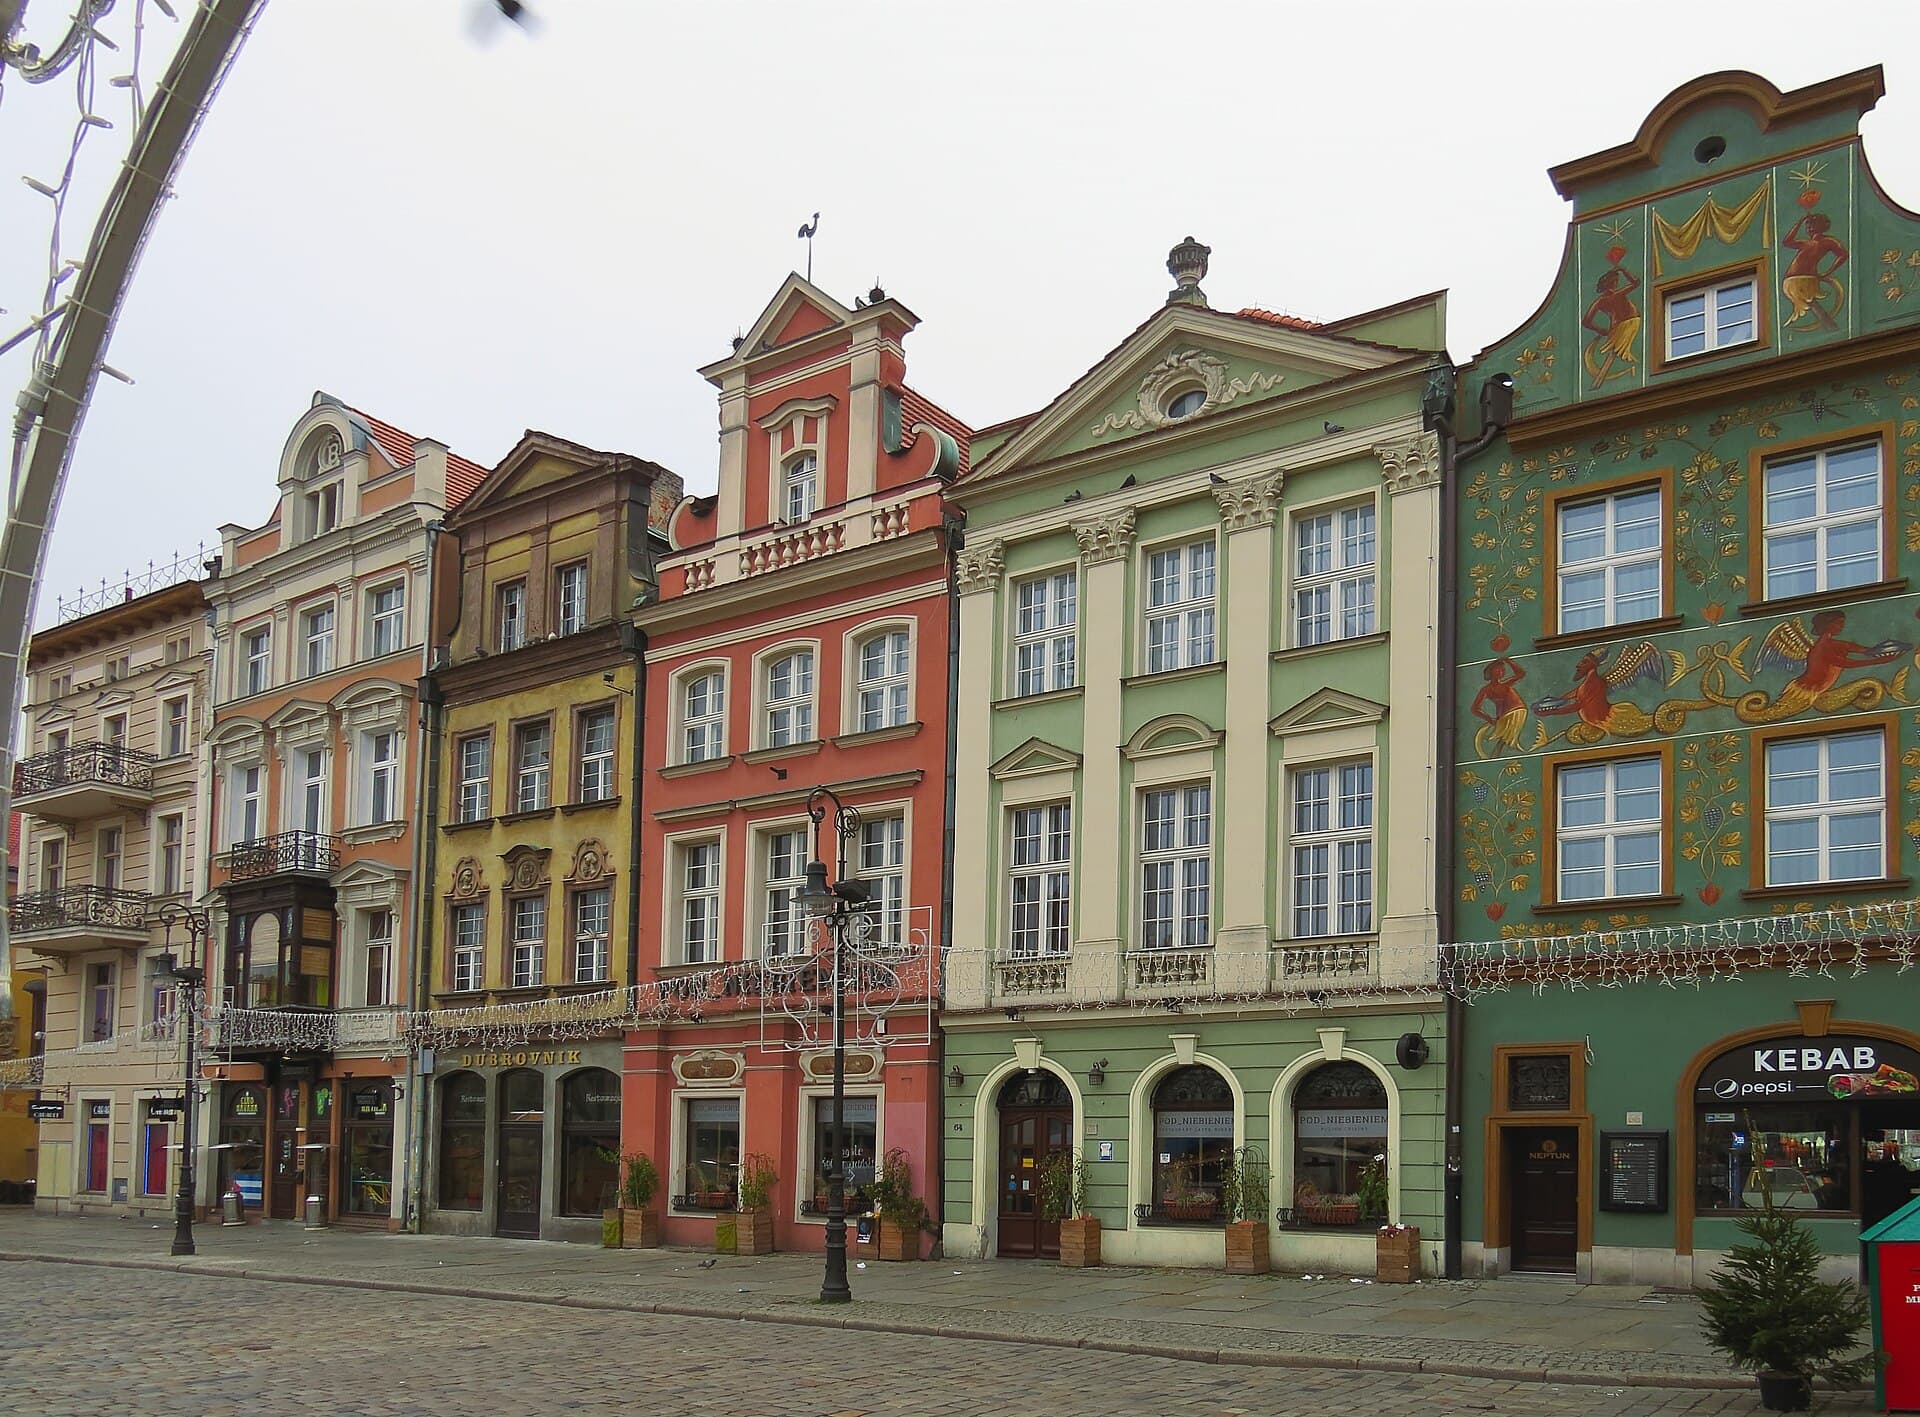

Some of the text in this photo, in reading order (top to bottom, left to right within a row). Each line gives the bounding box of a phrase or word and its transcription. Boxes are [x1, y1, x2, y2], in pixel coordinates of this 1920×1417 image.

[462, 1050, 582, 1068] DUBROVNIK
[1754, 1046, 1876, 1072] KEBAB
[1741, 1080, 1793, 1096] pepsi
